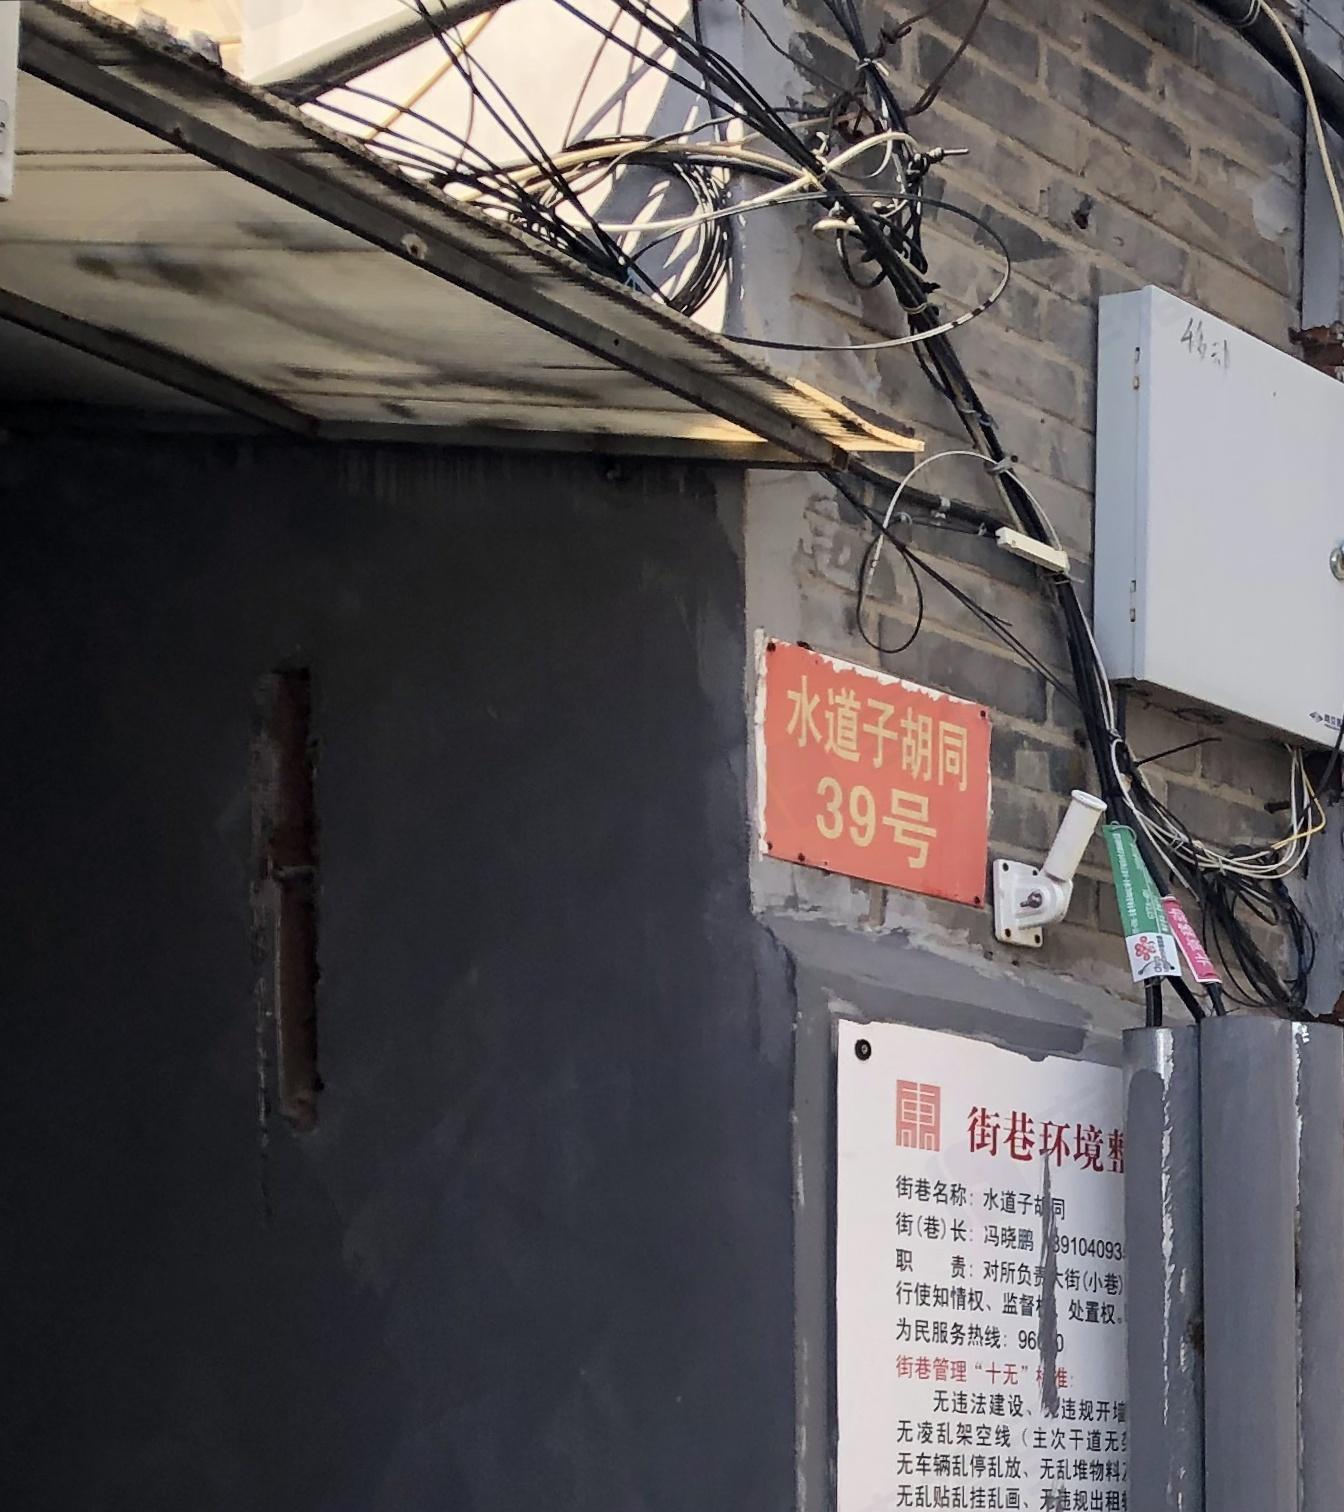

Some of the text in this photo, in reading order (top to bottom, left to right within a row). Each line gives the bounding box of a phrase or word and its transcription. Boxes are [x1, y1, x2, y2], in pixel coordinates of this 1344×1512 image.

[786, 675, 969, 792] 水道子胡同
[816, 776, 937, 870] 39号
[895, 1317, 1065, 1352] 为民服务热线：960
